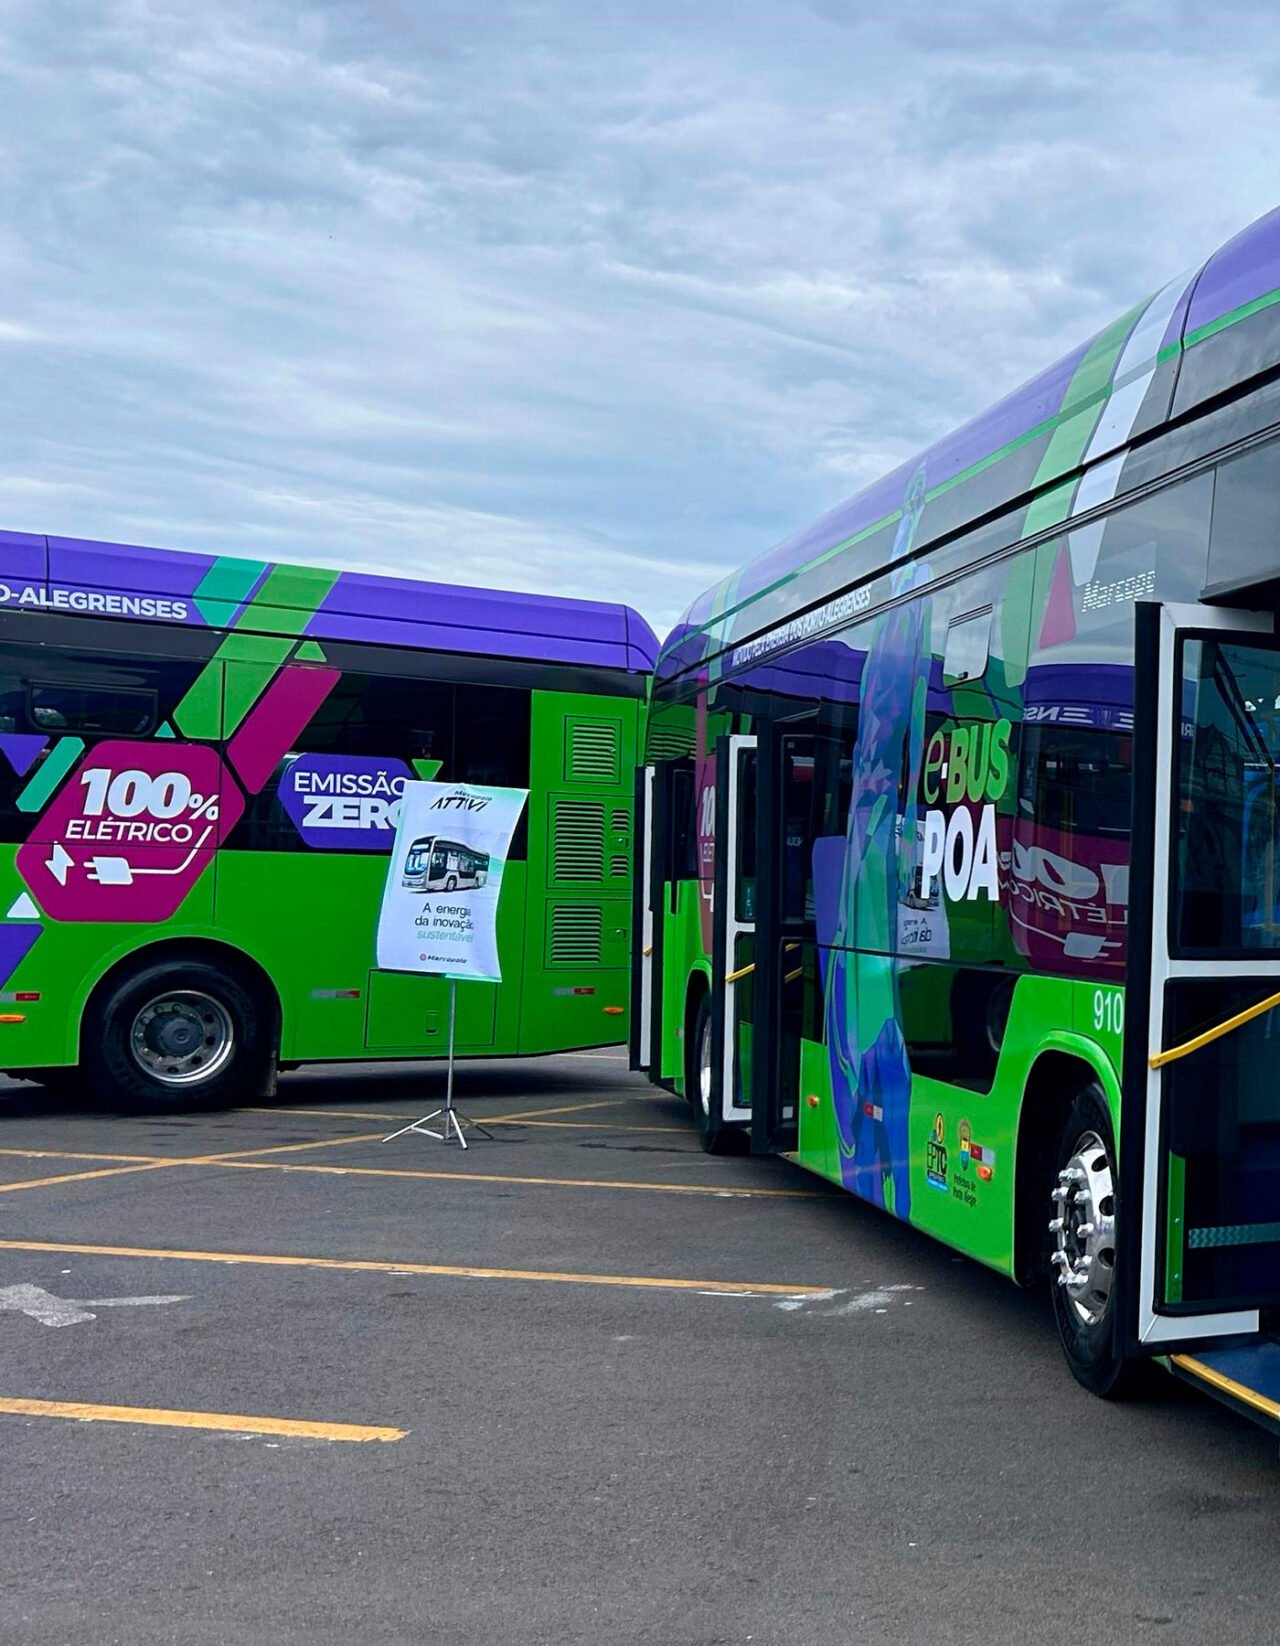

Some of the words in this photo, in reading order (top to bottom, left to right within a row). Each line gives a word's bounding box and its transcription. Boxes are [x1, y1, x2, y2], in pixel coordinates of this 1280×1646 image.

[924, 718, 1012, 805] e-BUS
[80, 768, 219, 821] 100%
[294, 771, 409, 797] EMISSÃO
[65, 816, 193, 843] ELÉTRICO
[921, 803, 1000, 902] POA
[414, 915, 429, 926] da
[422, 902, 432, 913] A
